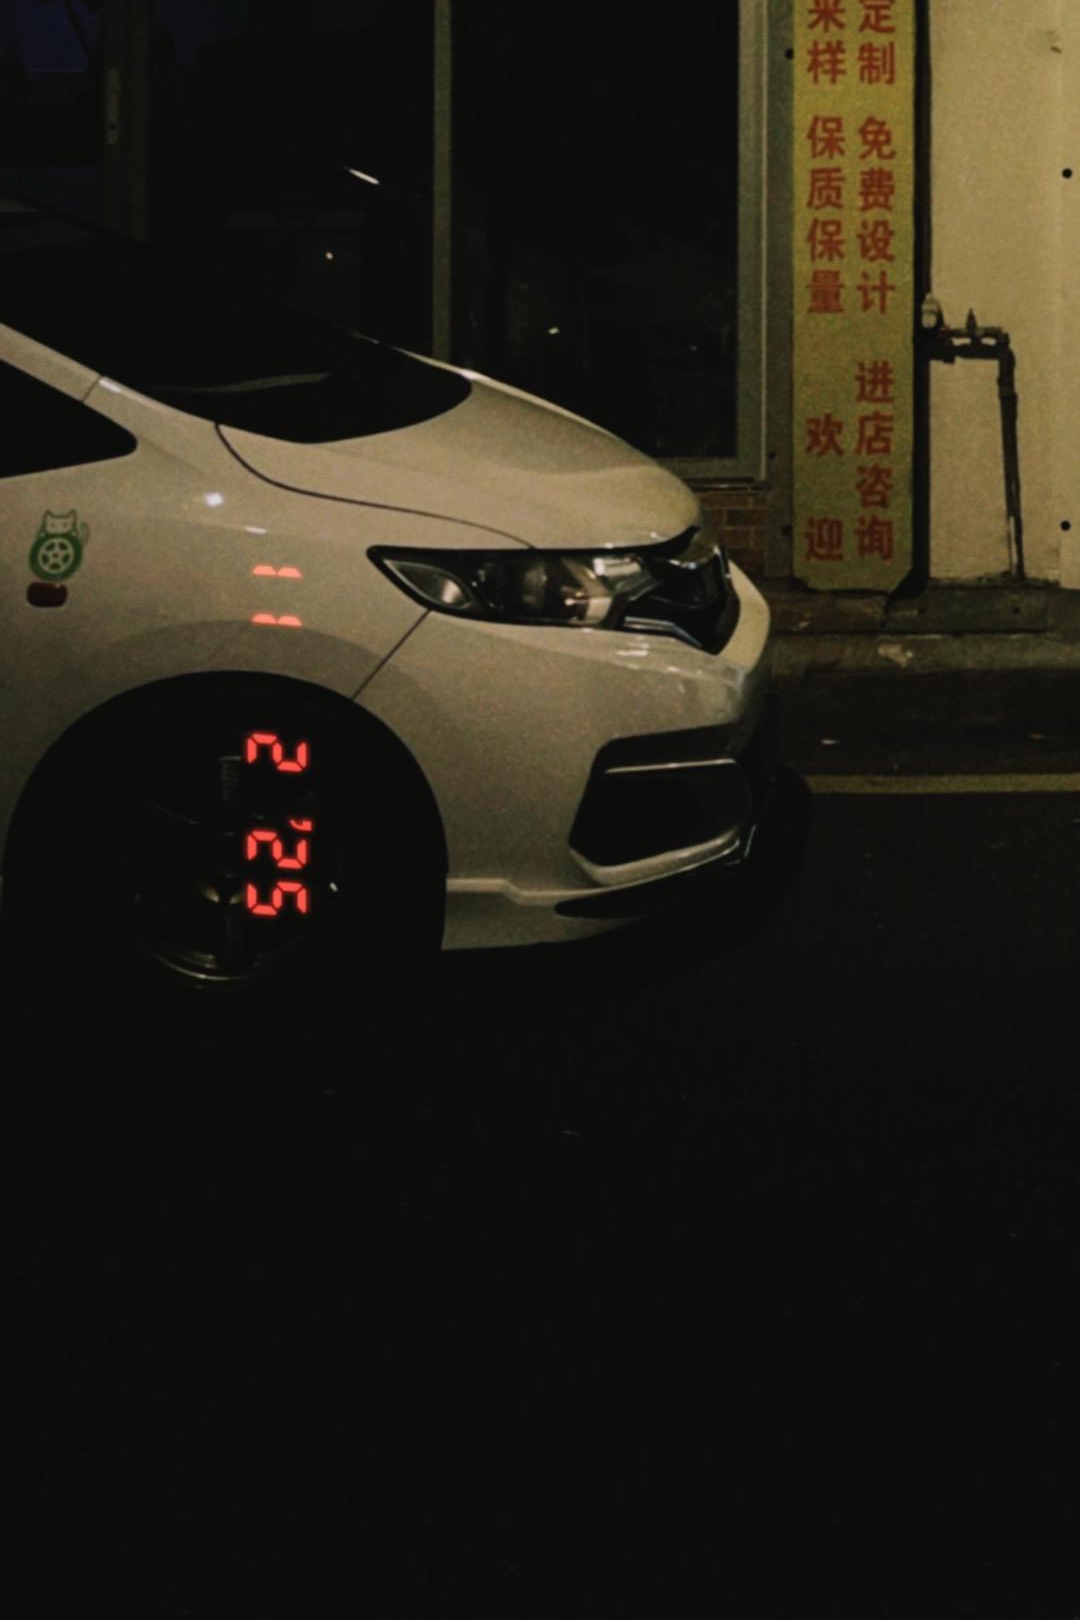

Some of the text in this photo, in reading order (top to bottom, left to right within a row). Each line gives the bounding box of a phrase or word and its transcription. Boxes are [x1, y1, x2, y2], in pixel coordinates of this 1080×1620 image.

[805, 115, 846, 315] 保质保量
[856, 115, 897, 316] 免费设计
[804, 412, 844, 562] 欢迎
[854, 360, 895, 561] 进店咨询
